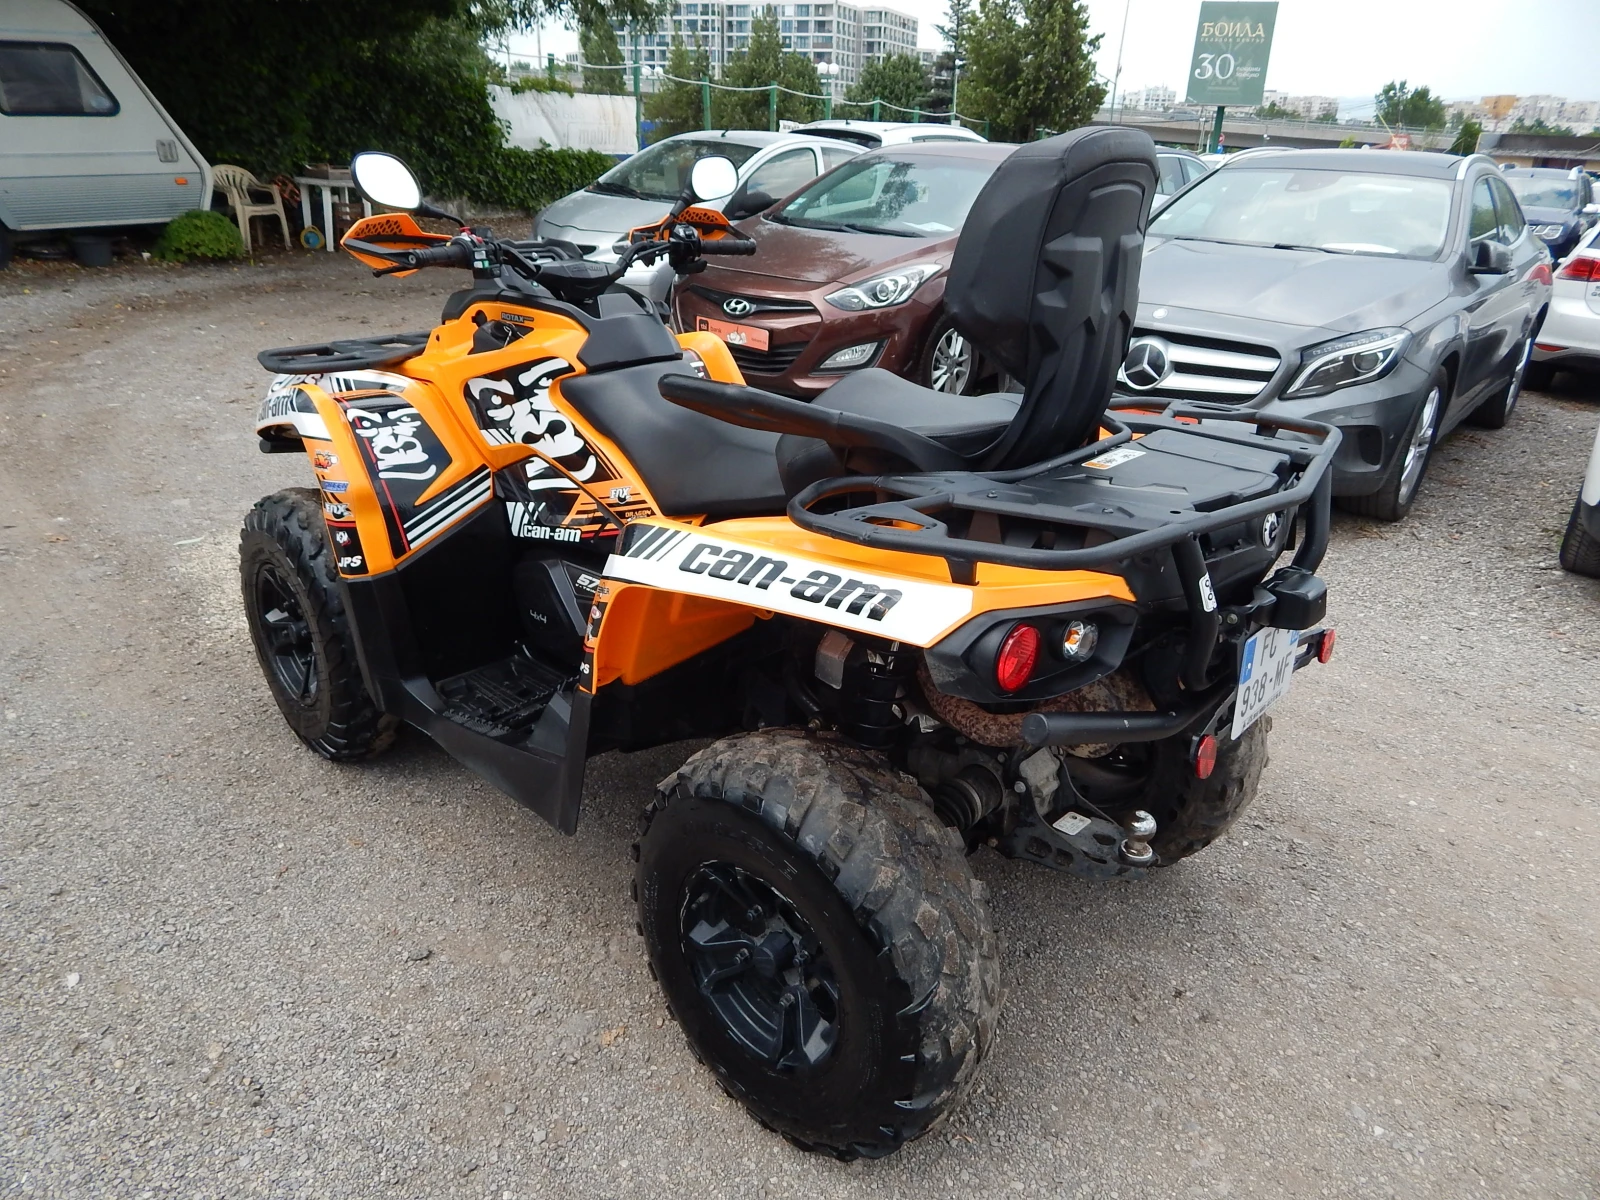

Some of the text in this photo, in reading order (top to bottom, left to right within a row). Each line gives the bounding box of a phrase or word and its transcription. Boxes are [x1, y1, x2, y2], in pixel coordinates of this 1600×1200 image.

[1201, 22, 1265, 37] БОИЛА
[1194, 53, 1235, 80] 30
[501, 312, 524, 322] ROTAX
[609, 486, 631, 500] FOX
[324, 501, 350, 516] FOX
[625, 509, 652, 518] DRAGON
[523, 524, 582, 543] can-am
[338, 555, 362, 568] JPS
[577, 573, 601, 589] 57
[679, 543, 903, 622] can-am
[529, 608, 547, 624] 4x4
[1260, 628, 1280, 667] FC
[580, 661, 590, 675] PS
[1240, 650, 1293, 718] 938-MF
